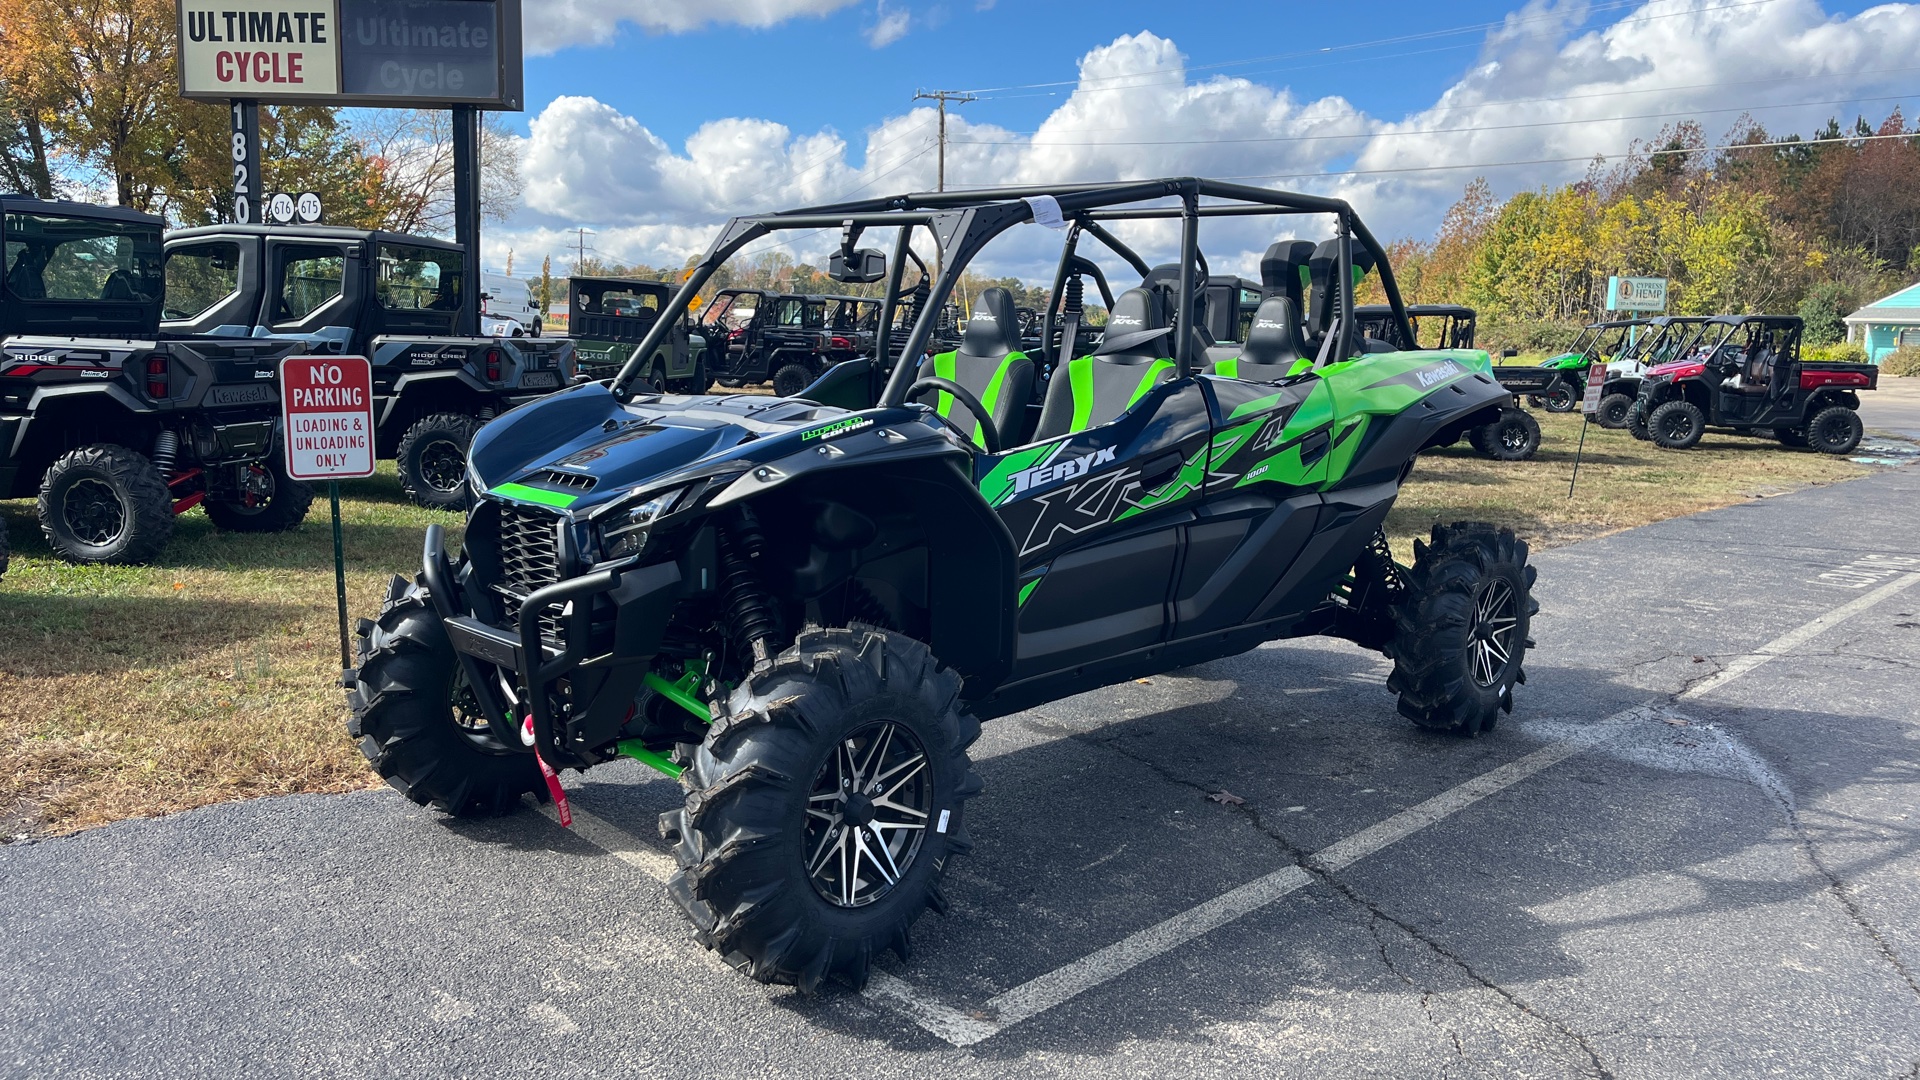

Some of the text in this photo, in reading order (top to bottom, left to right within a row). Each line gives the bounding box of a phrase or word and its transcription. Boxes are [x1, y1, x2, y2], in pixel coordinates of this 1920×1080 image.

[188, 11, 327, 43] ULTIMATE
[356, 17, 489, 48] Ultimate
[216, 51, 304, 84] CYCLE
[380, 60, 465, 95] Cycle
[232, 102, 250, 224] 1820
[274, 201, 291, 215] 676
[301, 200, 318, 214] 675
[1636, 290, 1662, 299] HEMP
[1112, 318, 1142, 326] KRX
[1255, 322, 1285, 330] KRX
[14, 354, 56, 362] RIDGE
[575, 351, 611, 361] ROXOR
[310, 365, 343, 385] NO
[523, 373, 554, 388] Kawasaki
[1415, 359, 1460, 388] Kawasaki
[212, 385, 269, 404] Kawasaki
[293, 387, 362, 407] PARKING
[296, 418, 362, 433] LOADING &
[801, 416, 863, 441] LIFTED
[820, 419, 874, 440] EDITION
[1250, 414, 1284, 453] 4
[296, 435, 365, 450] UNLOADING
[316, 453, 347, 468] ONLY
[1007, 443, 1118, 494] TERYX
[1246, 464, 1269, 481] 1000
[558, 797, 571, 824] WARN
